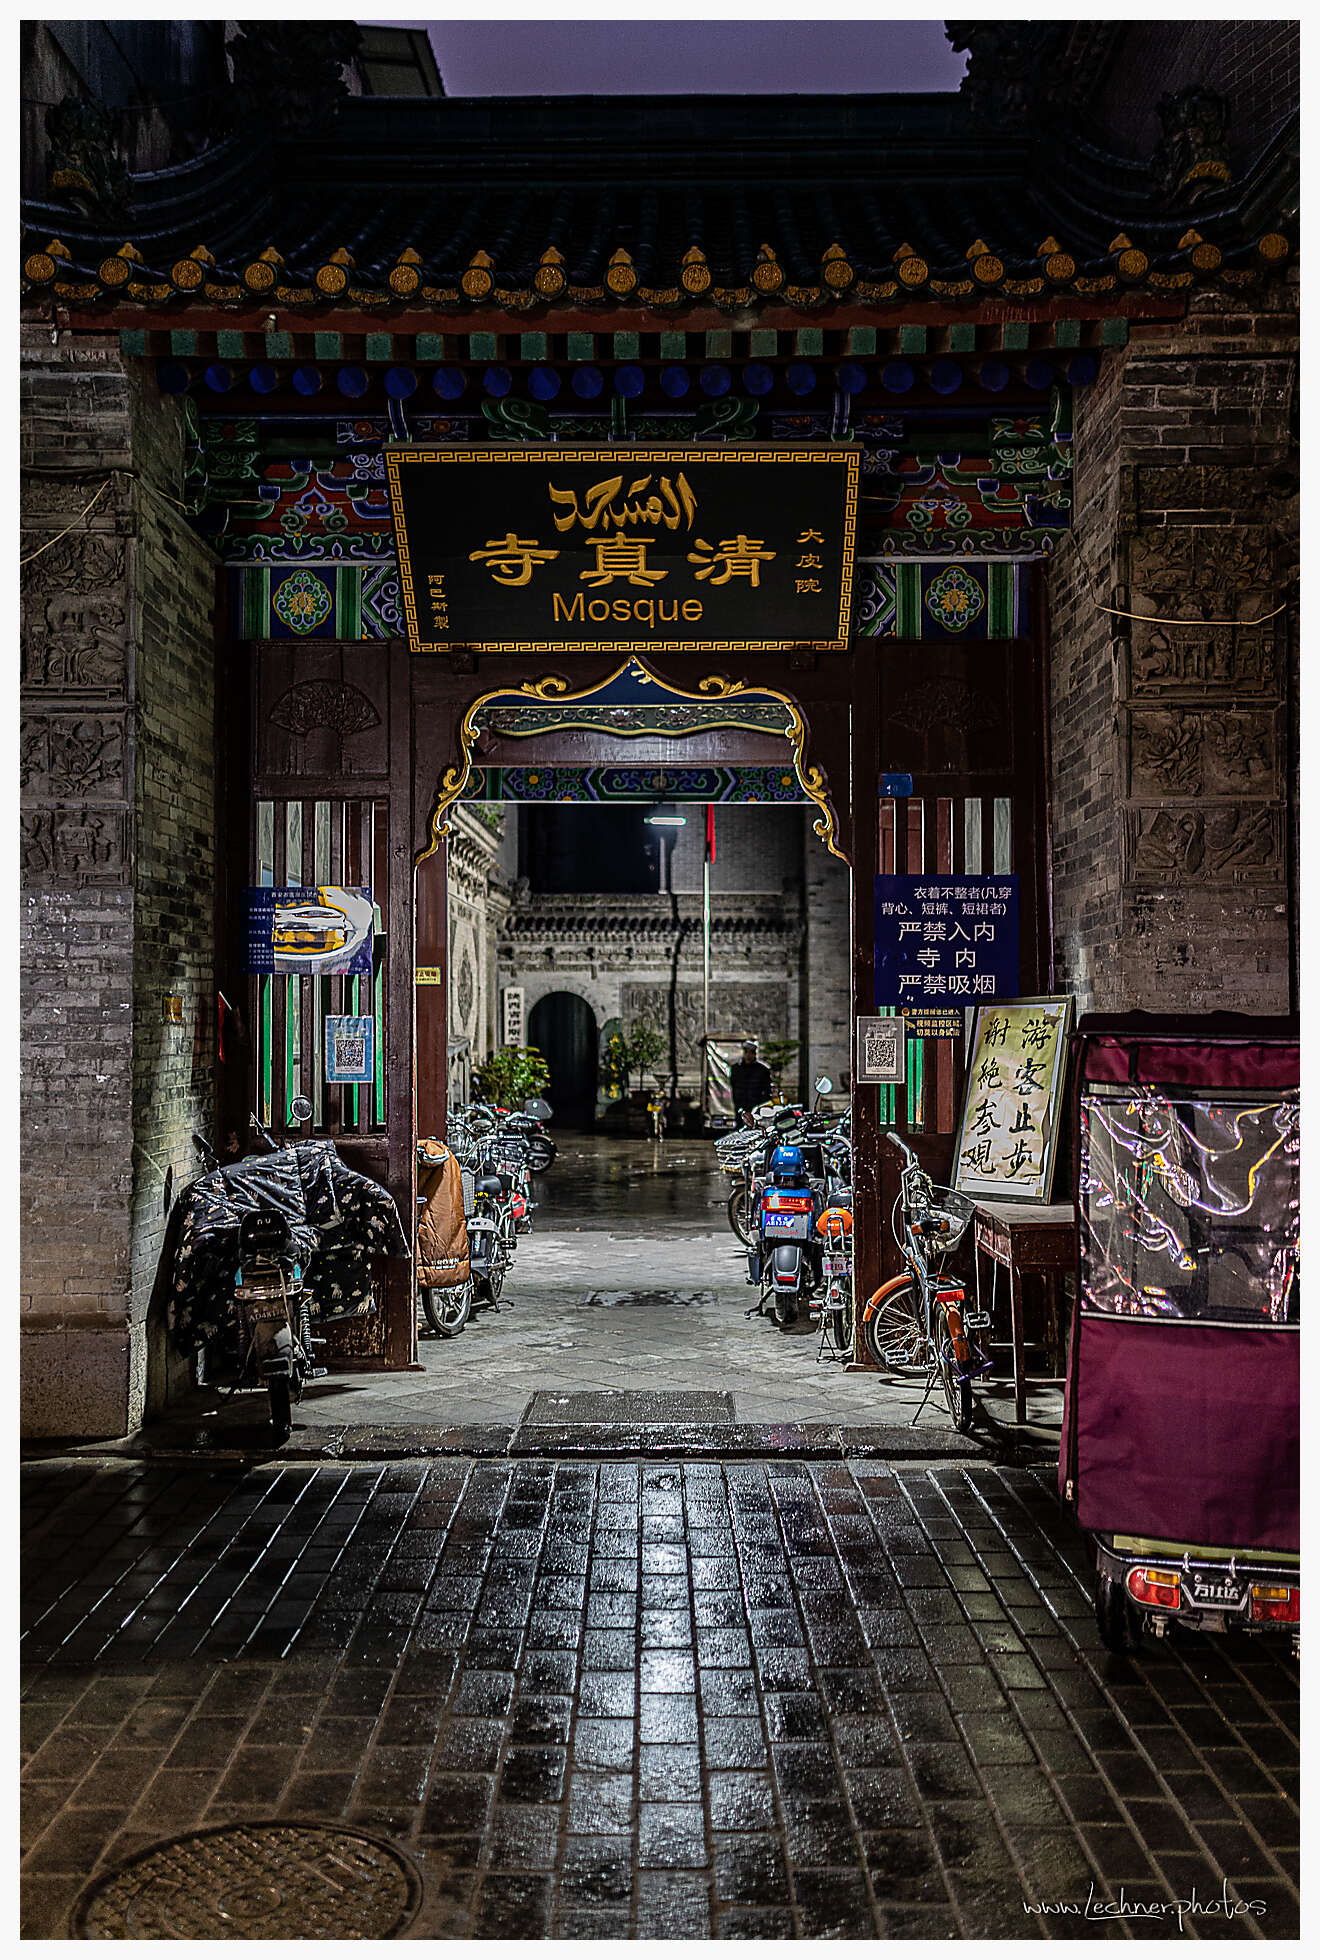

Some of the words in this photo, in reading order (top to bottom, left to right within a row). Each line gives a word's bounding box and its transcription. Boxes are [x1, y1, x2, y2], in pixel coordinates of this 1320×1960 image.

[795, 528, 825, 593] 大皮院
[552, 592, 703, 628] Mosque
[898, 921, 995, 942] 严禁入内
[898, 974, 996, 995] 严禁吸烟
